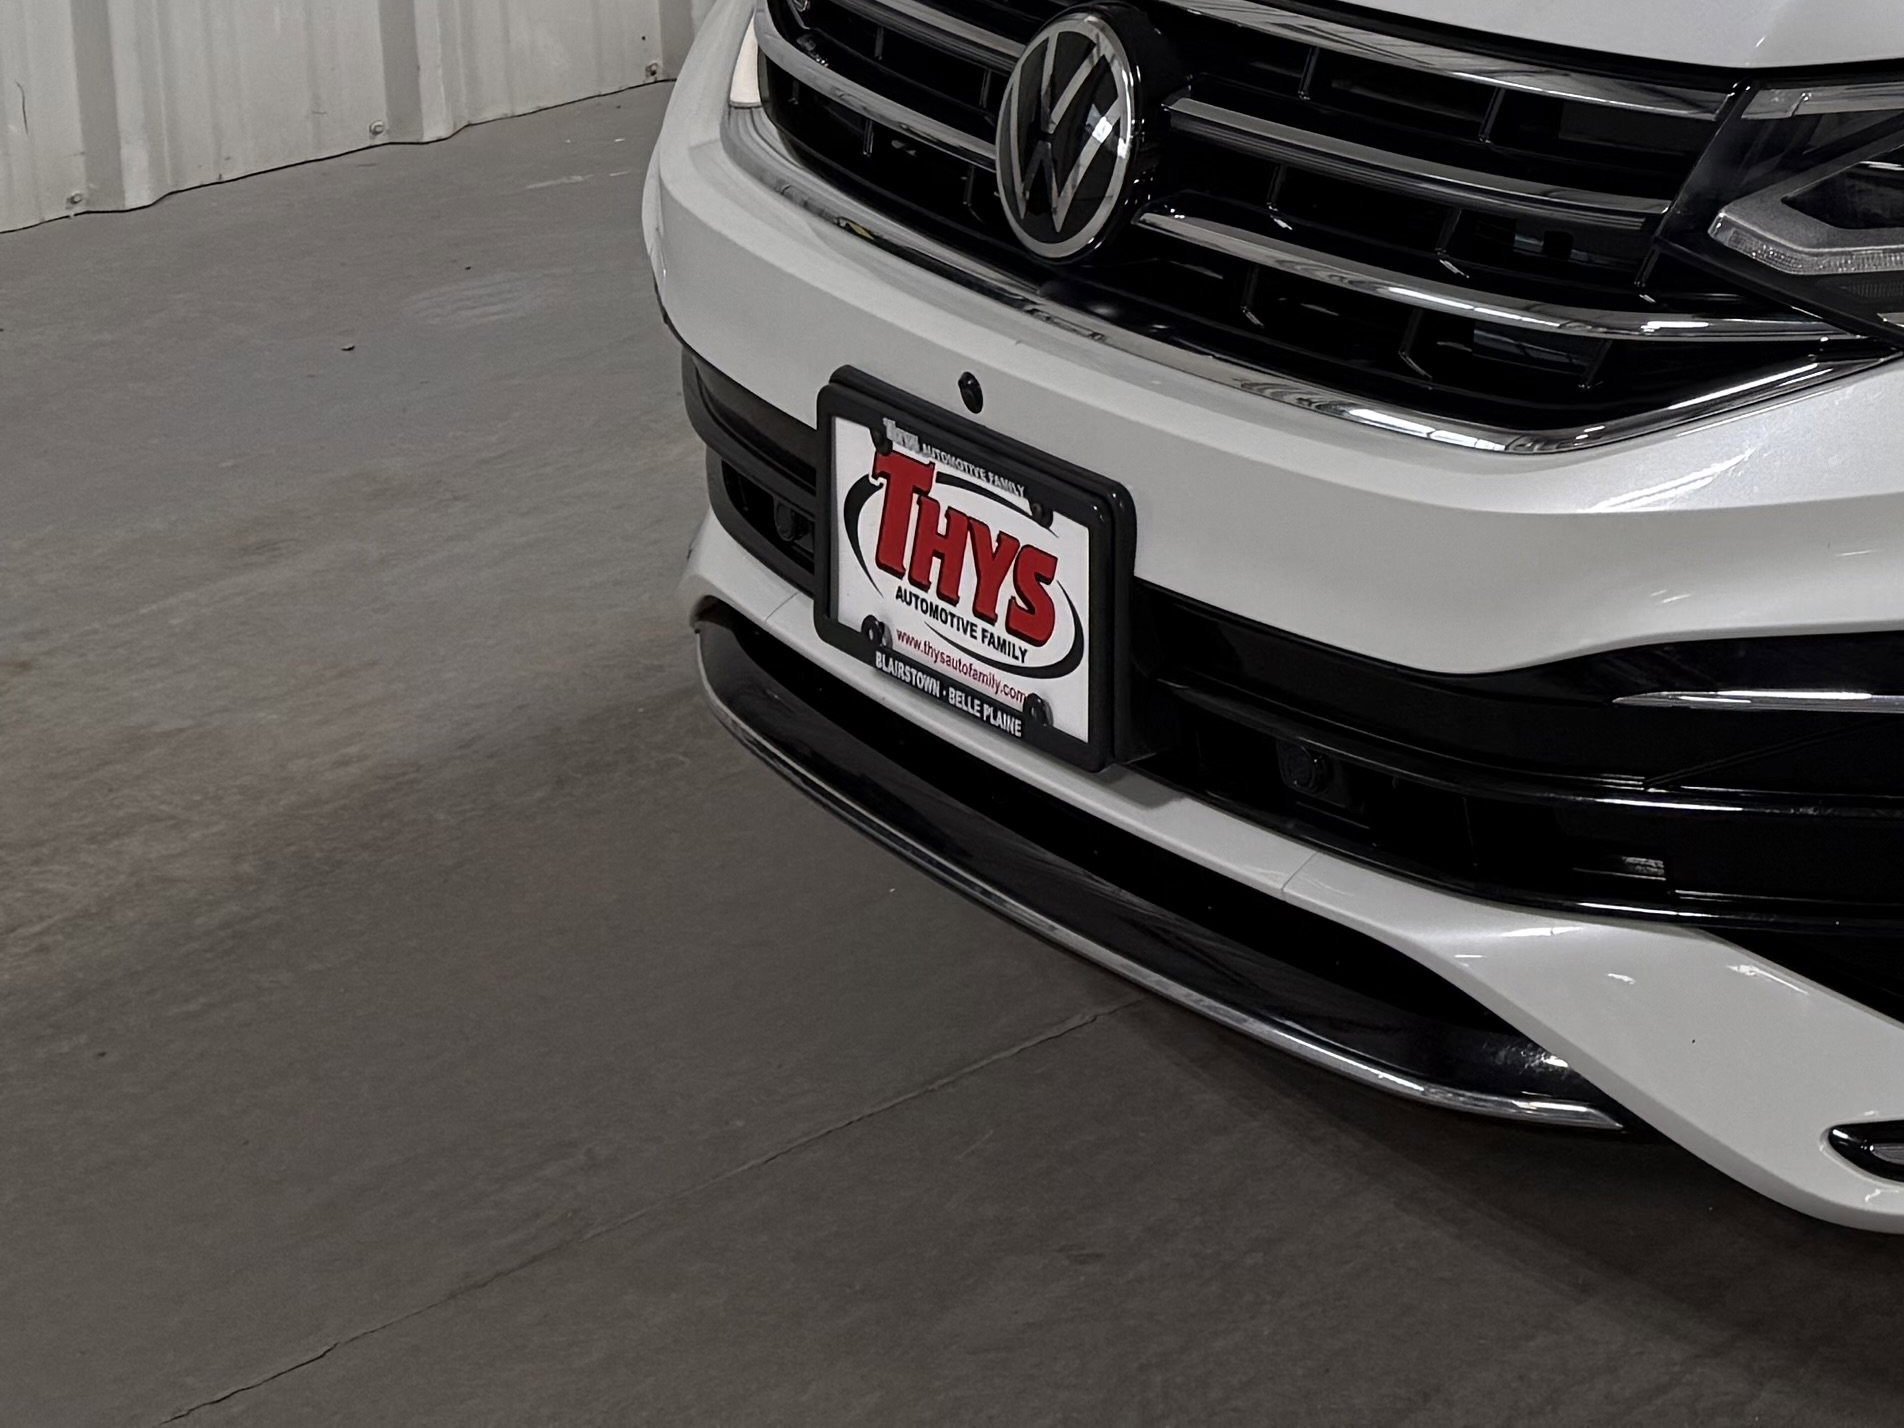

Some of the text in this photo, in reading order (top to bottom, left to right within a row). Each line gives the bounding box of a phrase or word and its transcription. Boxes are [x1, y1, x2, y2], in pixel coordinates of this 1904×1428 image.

[871, 449, 1059, 648] THYS
[895, 585, 1028, 664] AUTOMOTIVE FAMILY
[875, 650, 1022, 737] BLAIRSTOWN BELLE PLAINE
